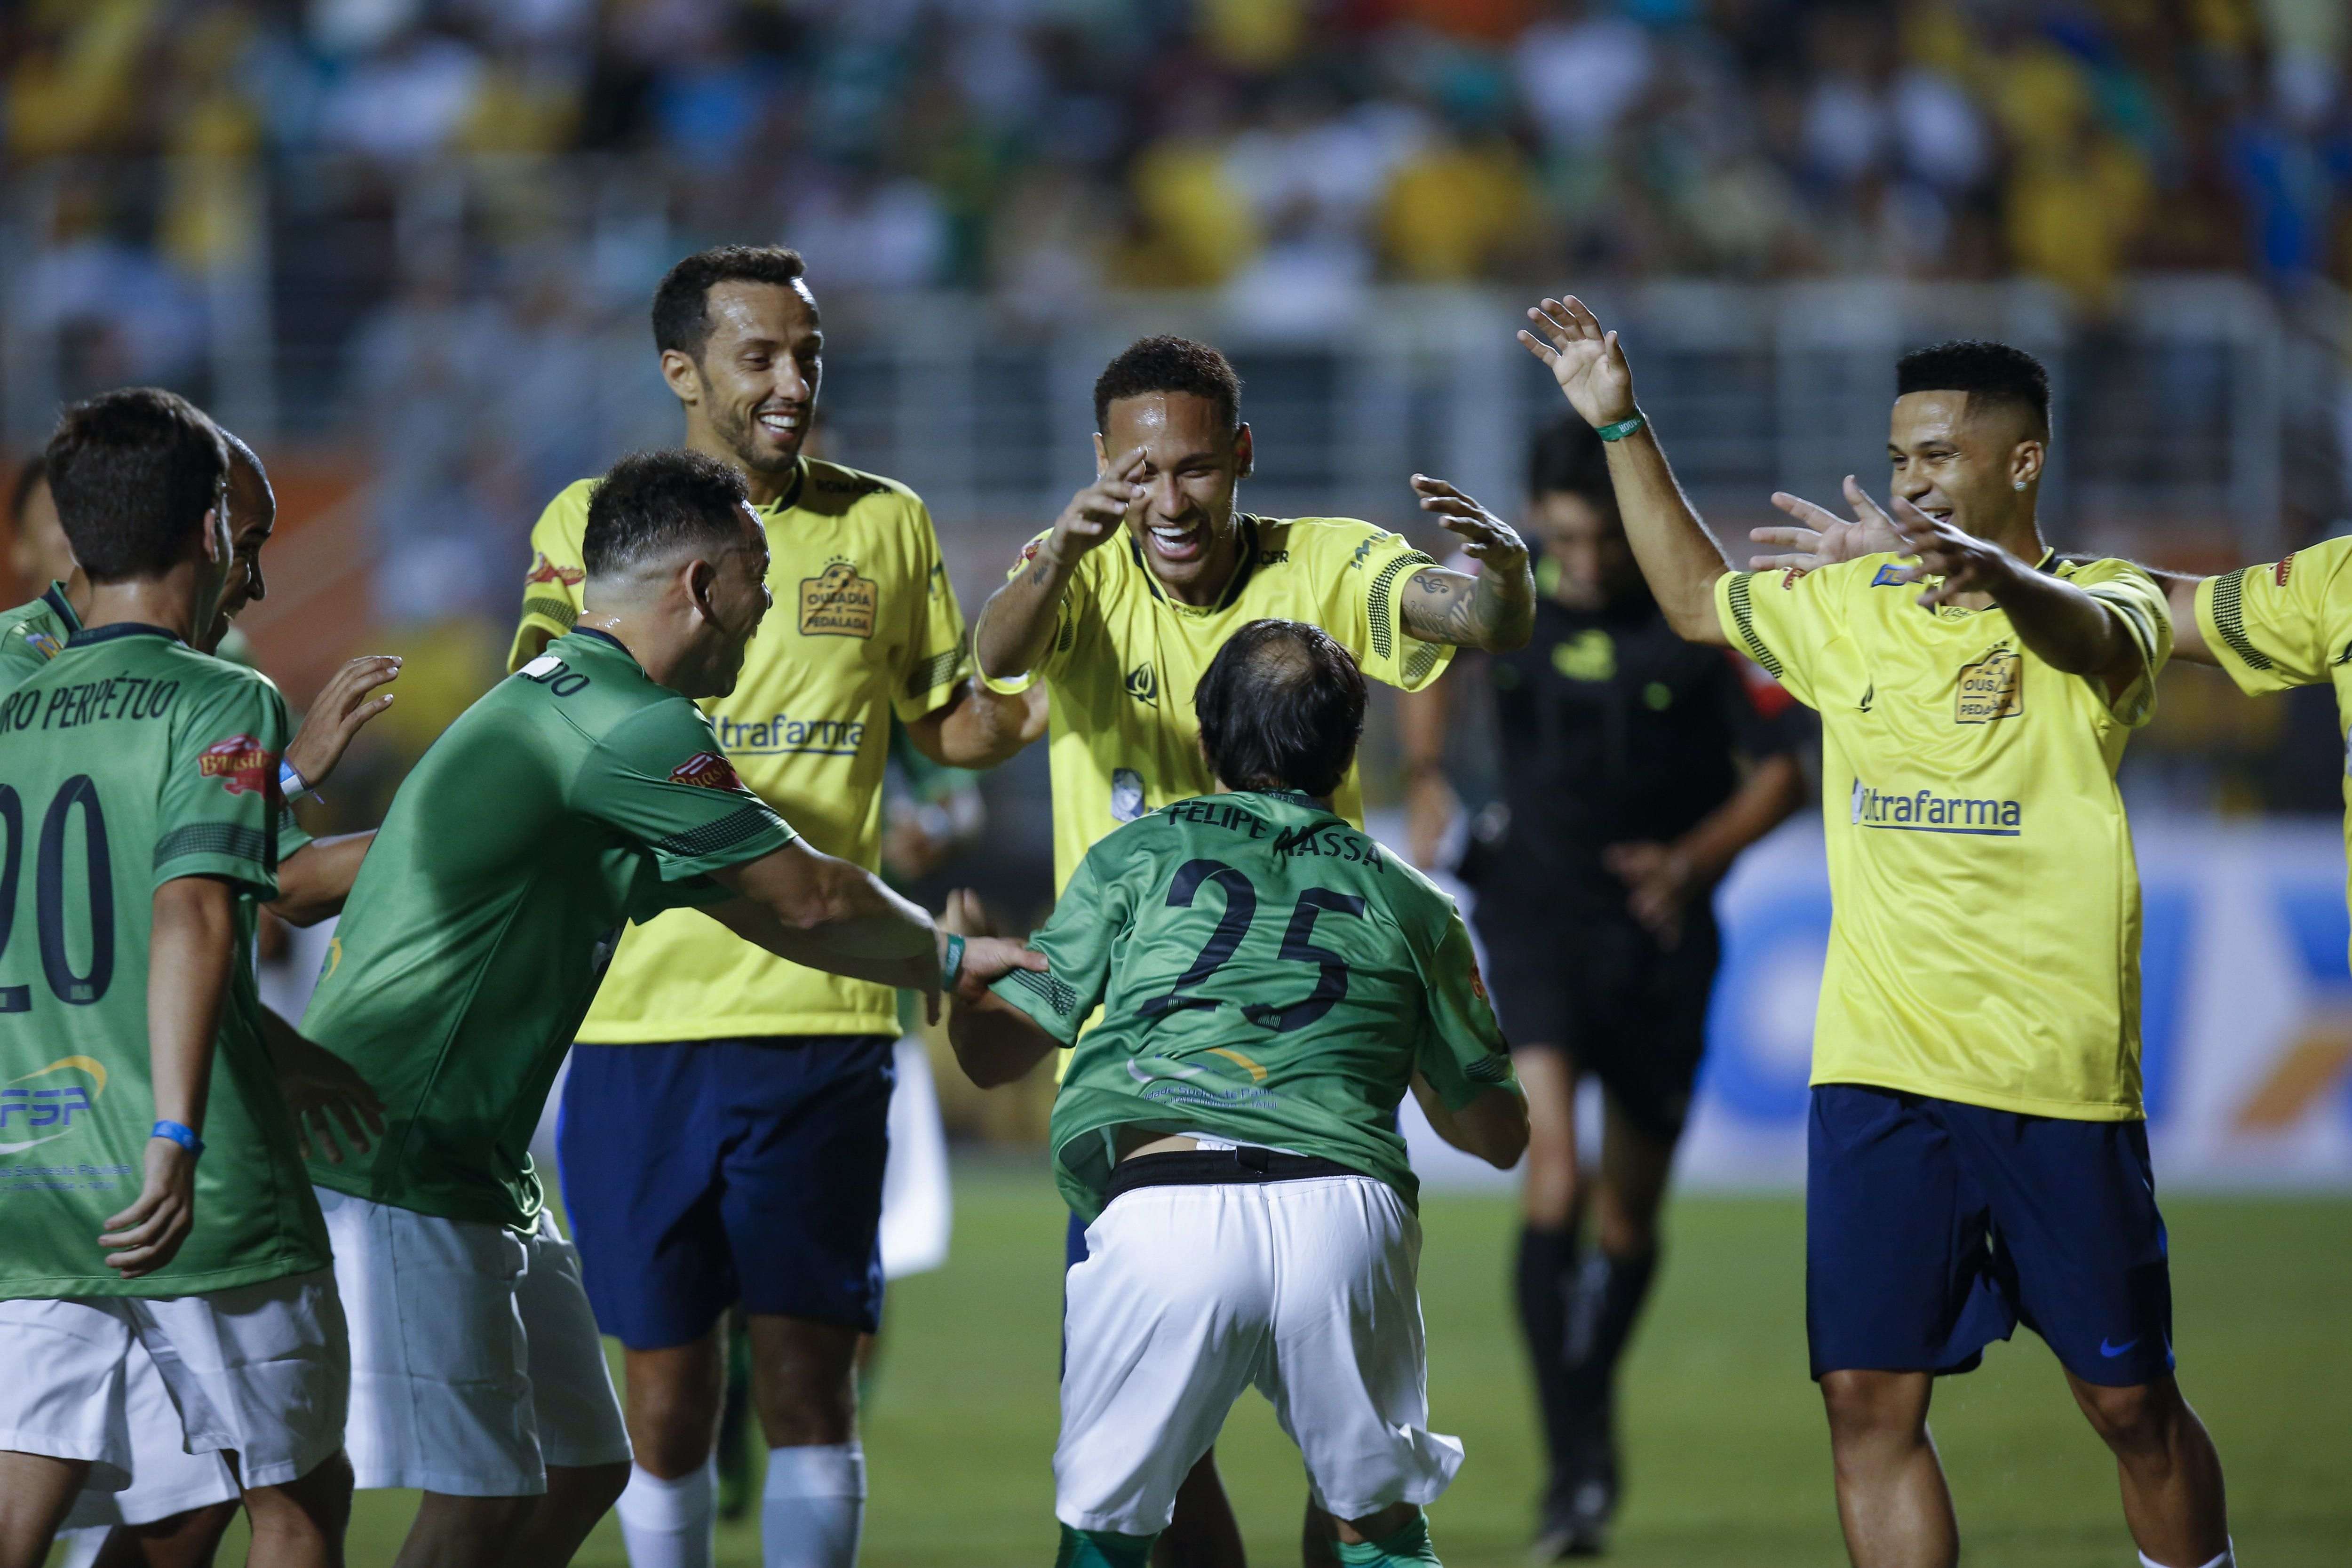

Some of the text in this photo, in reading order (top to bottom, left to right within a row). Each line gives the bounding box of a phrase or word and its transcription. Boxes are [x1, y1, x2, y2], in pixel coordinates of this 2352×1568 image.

[41, 669, 181, 730] PERPÉTUO
[1169, 801, 1384, 874] FELIPE MASSA
[1862, 788, 2021, 826] trafarma
[1134, 859, 1366, 1033] 25
